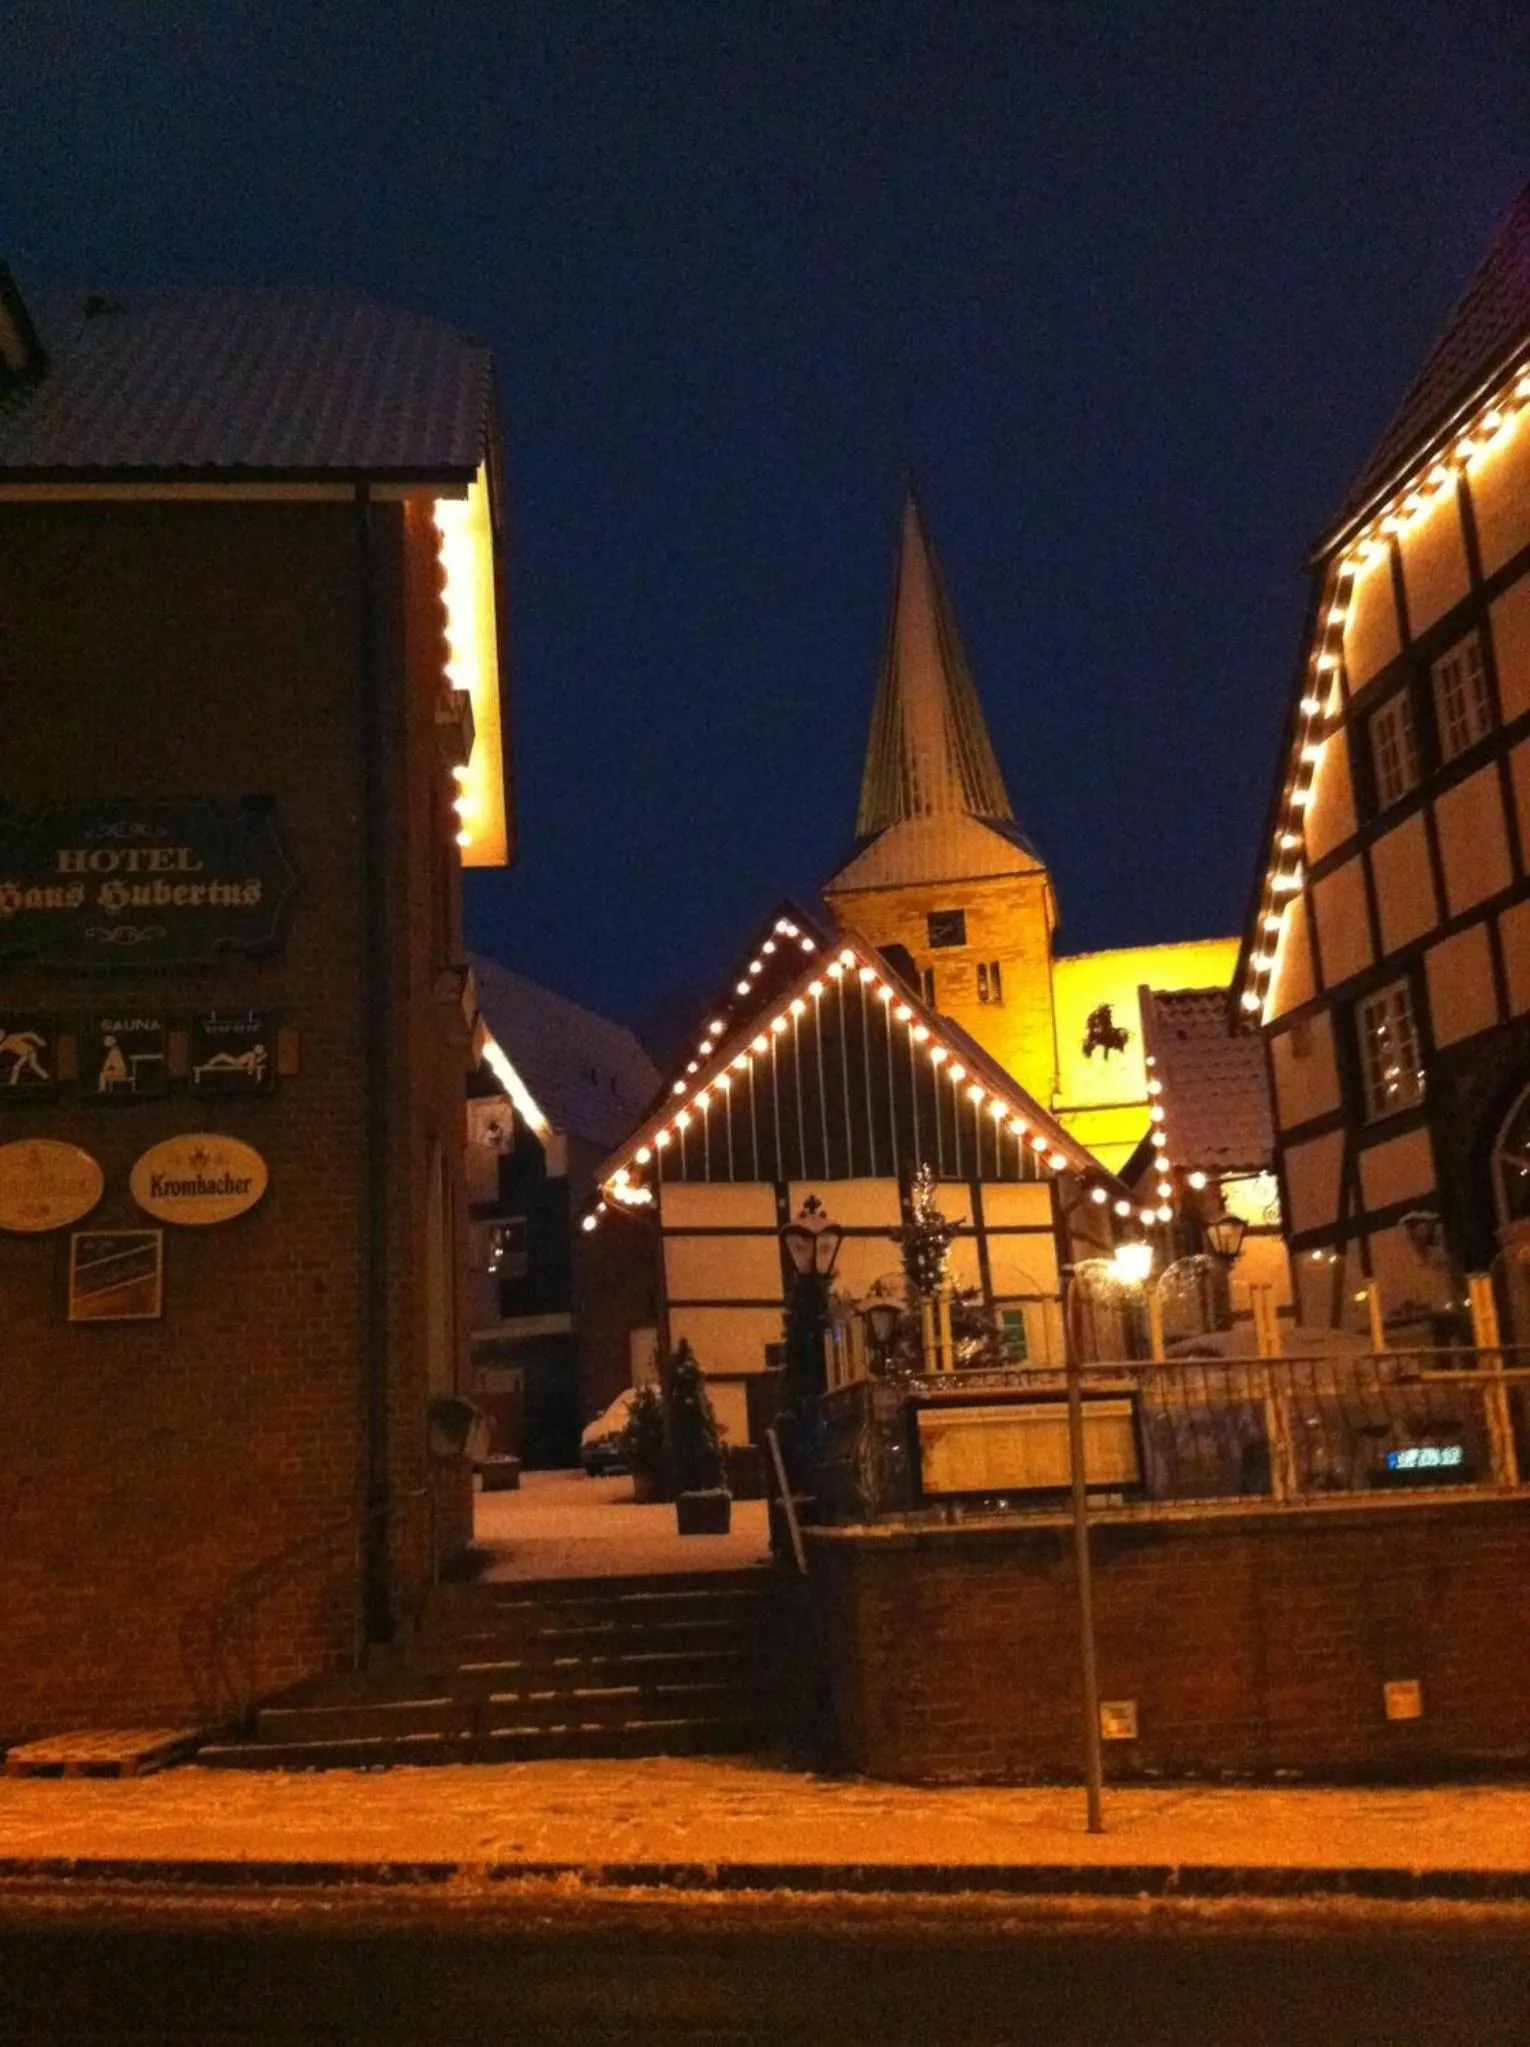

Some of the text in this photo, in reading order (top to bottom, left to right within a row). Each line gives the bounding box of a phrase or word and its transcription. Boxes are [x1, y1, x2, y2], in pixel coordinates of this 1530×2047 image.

[55, 847, 203, 873] HOTEL
[97, 878, 261, 915] Hubertus
[101, 1019, 161, 1032] SAUNA
[151, 1172, 253, 1198] Krombacher
